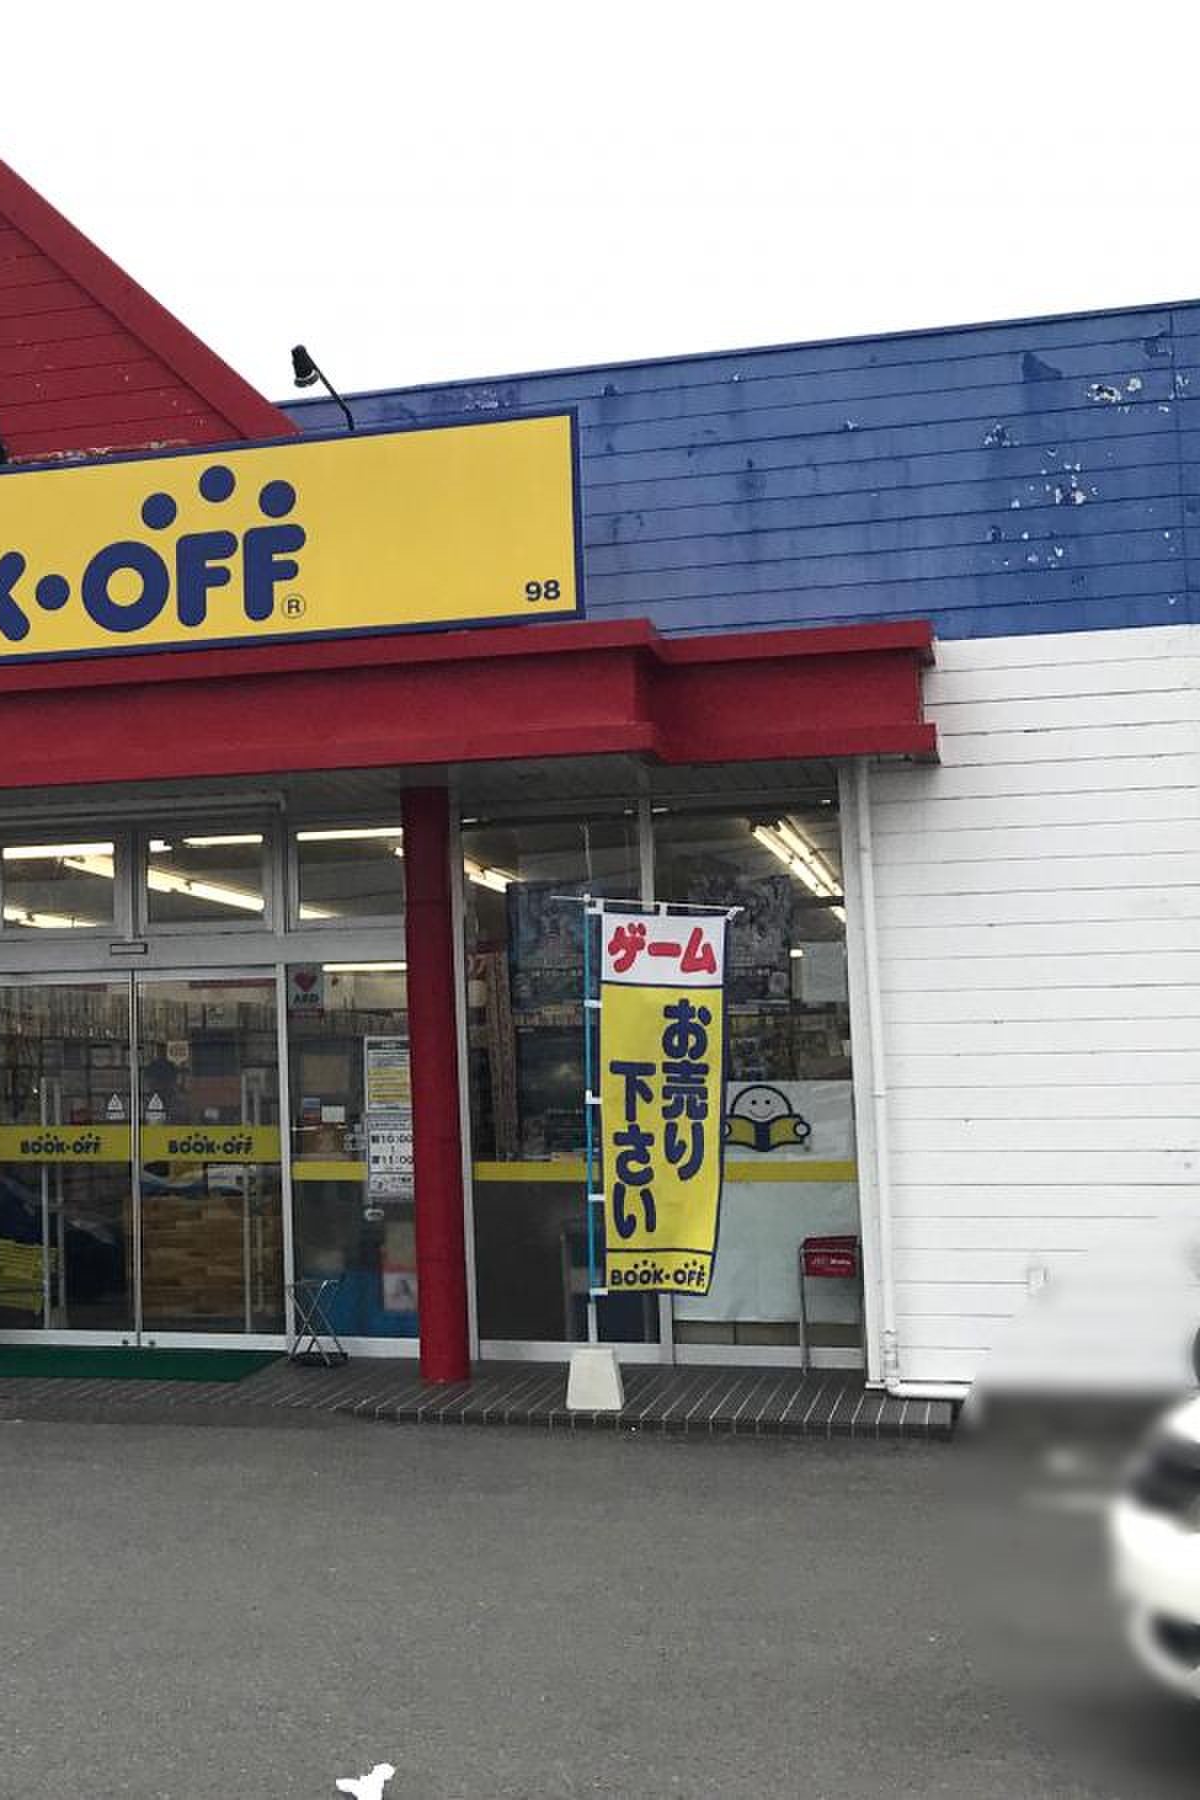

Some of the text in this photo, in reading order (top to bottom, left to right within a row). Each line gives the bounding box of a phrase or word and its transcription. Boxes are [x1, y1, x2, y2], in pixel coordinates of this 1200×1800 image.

[524, 579, 561, 602] 98
[607, 922, 717, 974] ゲーム
[662, 998, 712, 1181] お売り
[609, 1061, 656, 1239] 下さい
